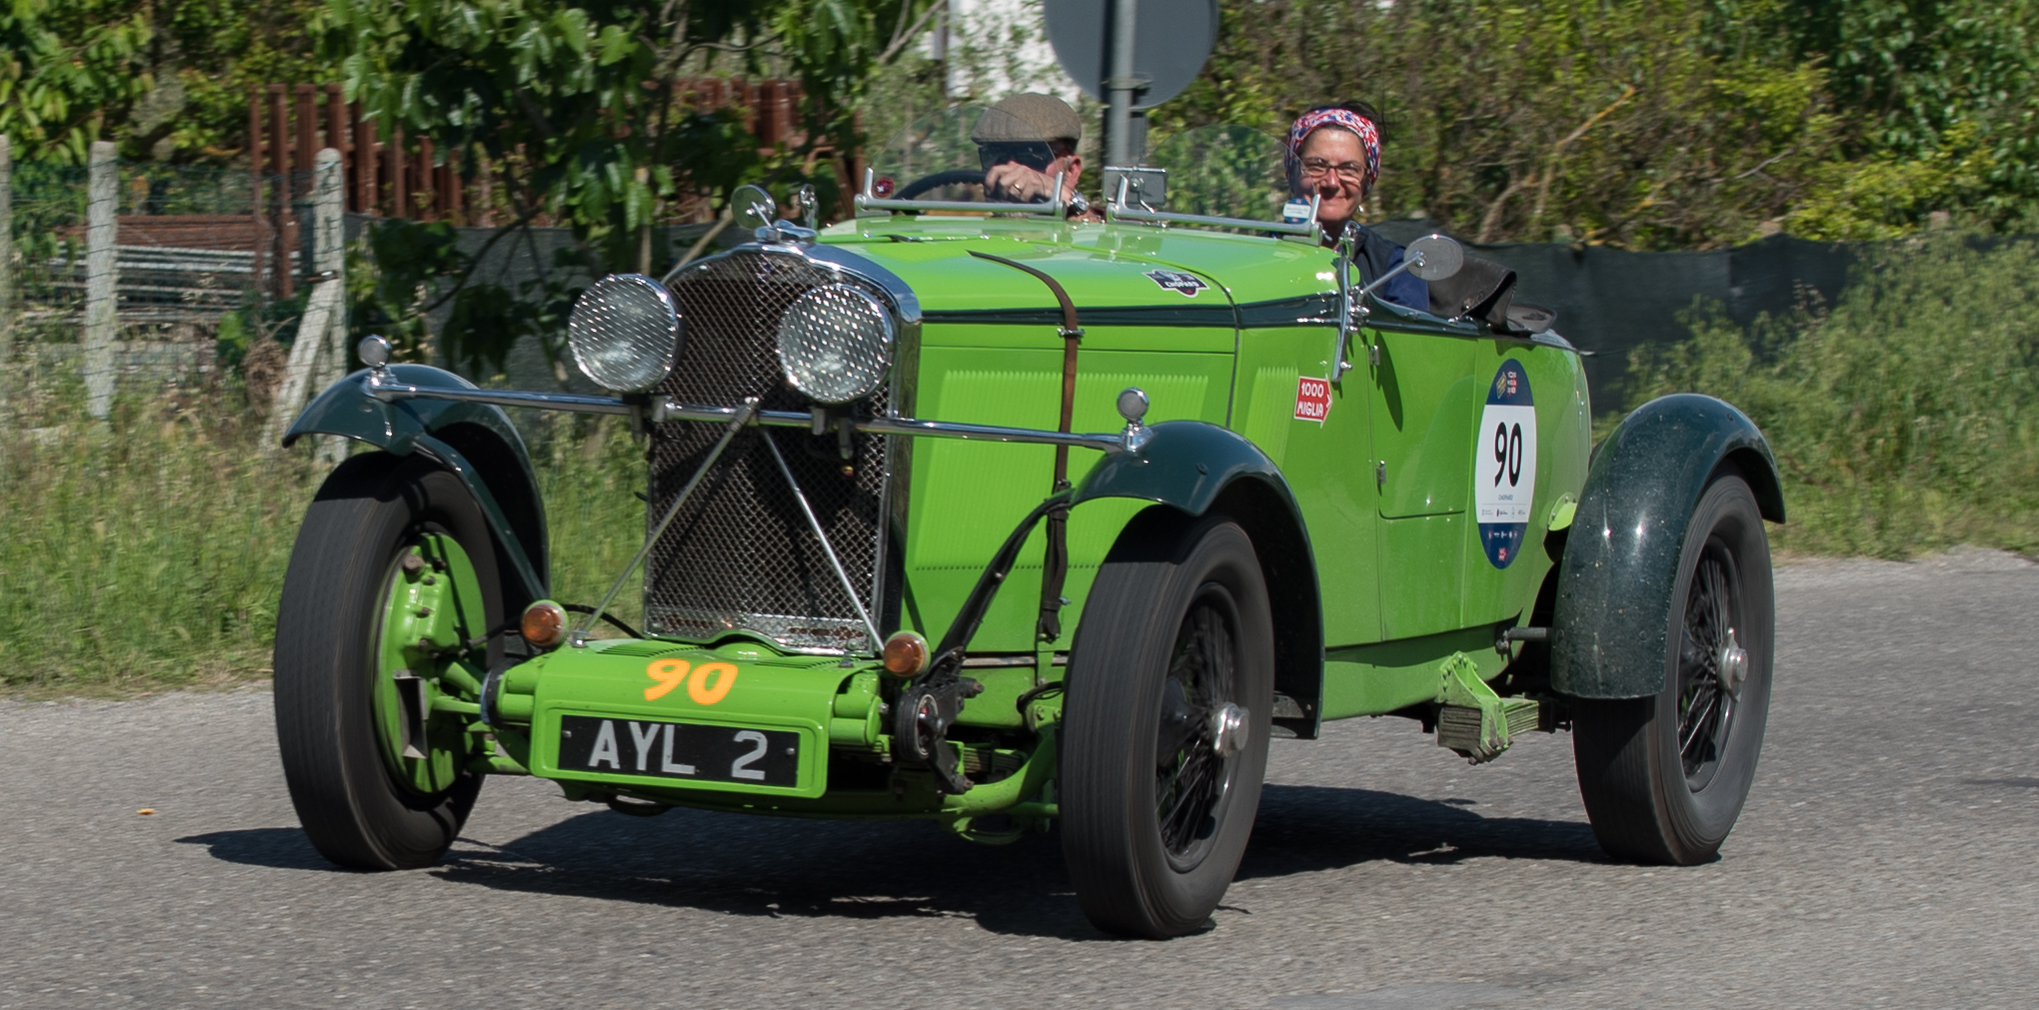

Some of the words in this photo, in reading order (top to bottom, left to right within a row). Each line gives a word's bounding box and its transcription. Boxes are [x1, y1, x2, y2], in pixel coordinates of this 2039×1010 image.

[1297, 401, 1324, 417] MIGLIA
[1301, 382, 1324, 398] 1000
[1494, 421, 1522, 488] 90
[644, 658, 738, 705] 90
[588, 719, 696, 775] AYL
[731, 730, 768, 780] 2
